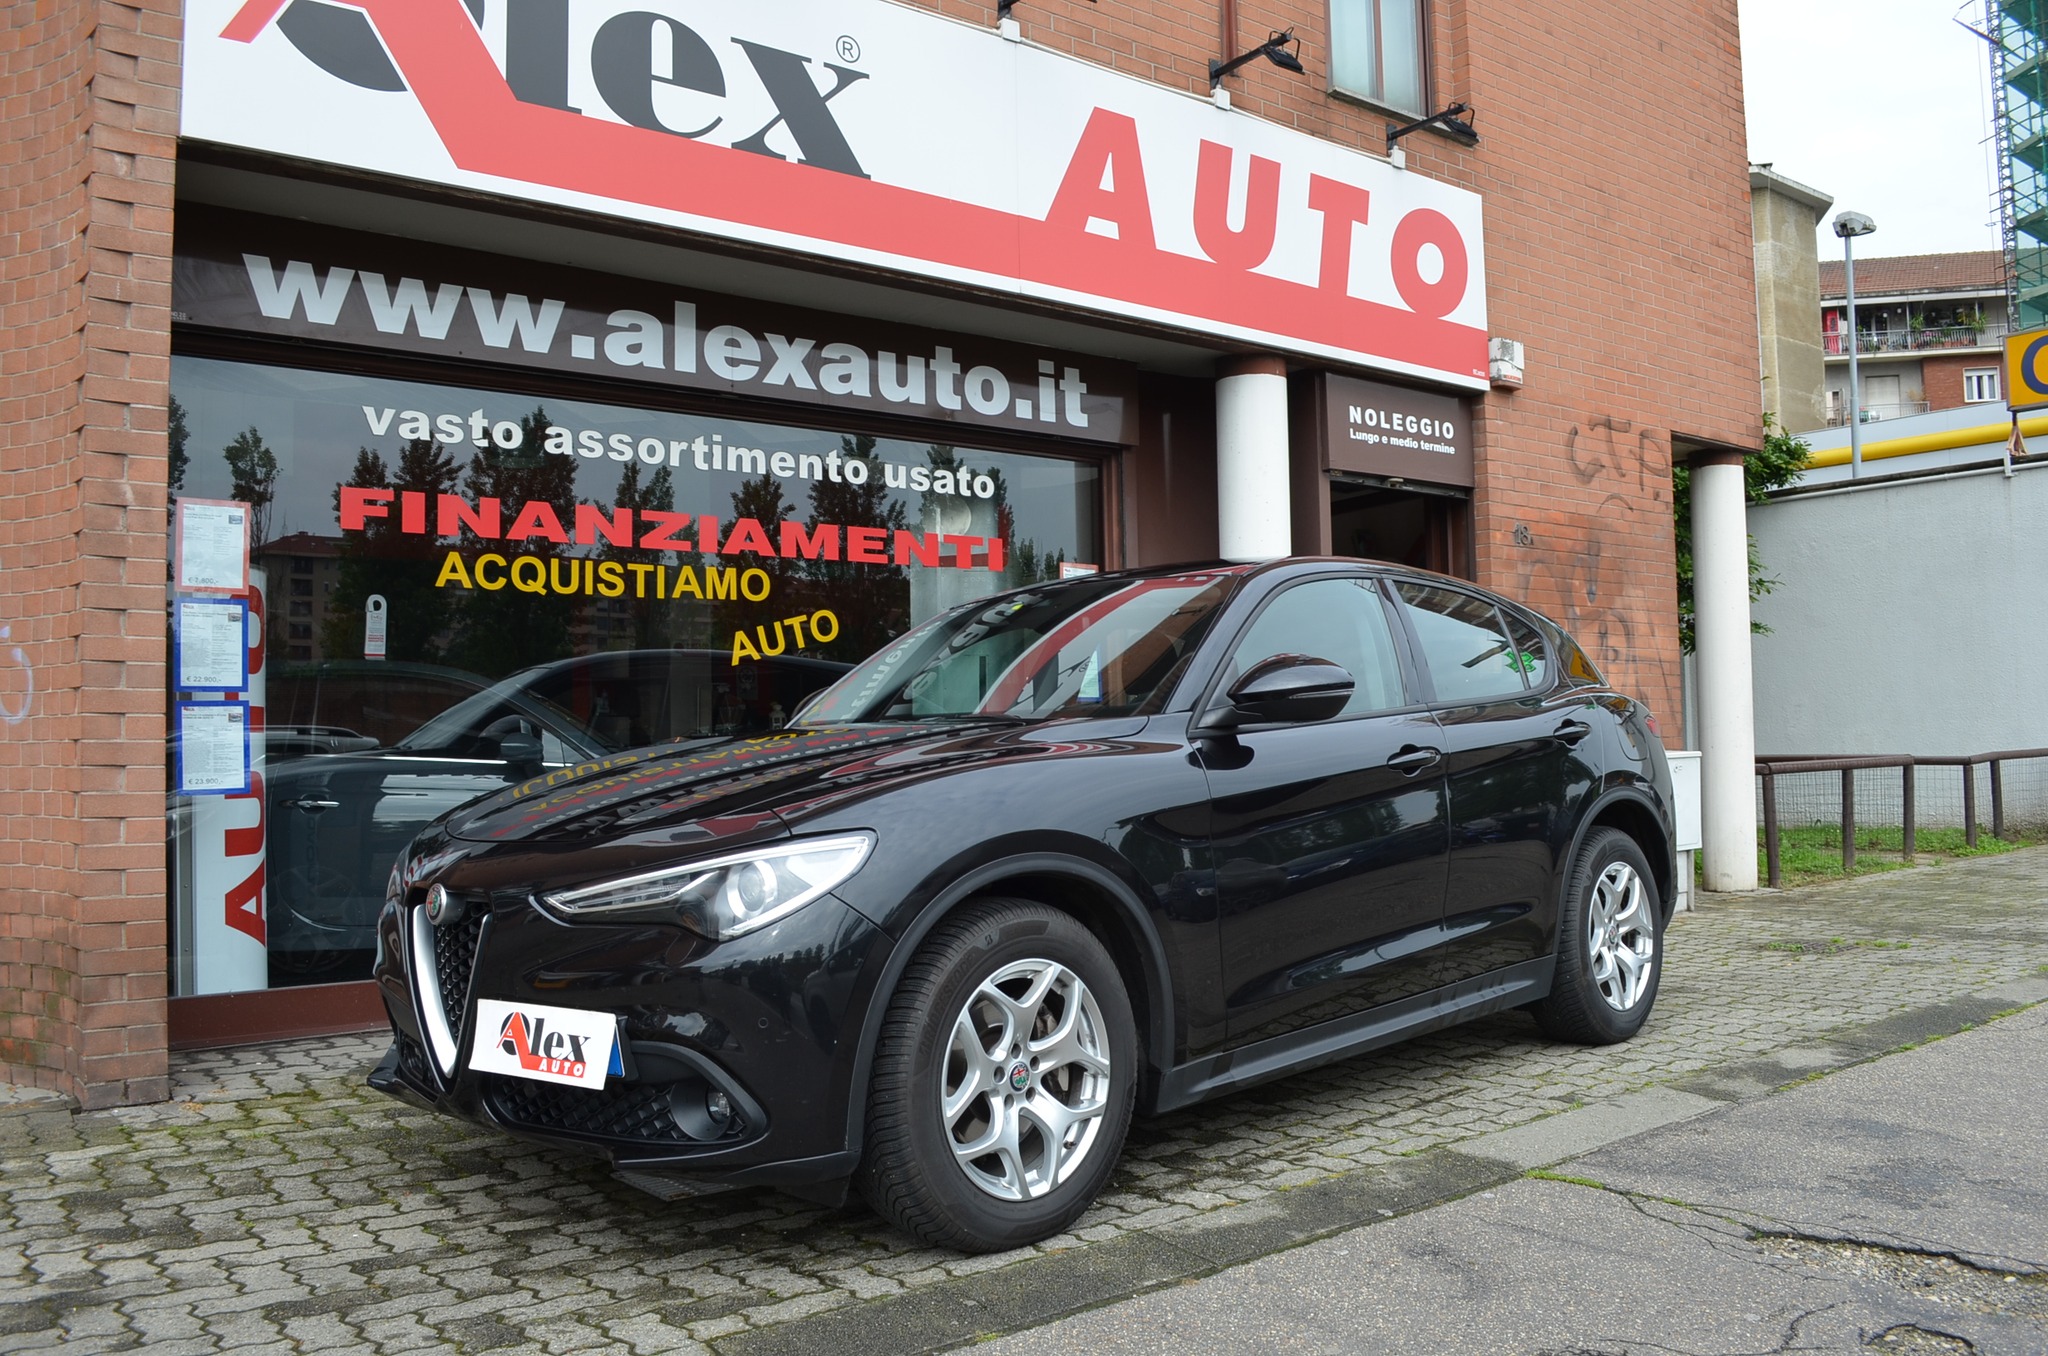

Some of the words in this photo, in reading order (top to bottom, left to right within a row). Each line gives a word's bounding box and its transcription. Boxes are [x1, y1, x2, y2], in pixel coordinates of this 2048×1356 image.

[1044, 106, 1468, 319] AUTO
[242, 252, 1089, 428] www.alexauto.it
[1349, 405, 1454, 439] NOLEGGIO
[1349, 428, 1380, 444] Lungo
[1381, 435, 1389, 444] e
[1390, 436, 1419, 449] medio
[1420, 440, 1456, 455] termine
[362, 405, 522, 450] vasto
[544, 425, 869, 485] assortimento
[884, 464, 995, 499] usato
[339, 486, 1006, 572] FINANZIAMENTI
[435, 551, 771, 602] ACQUISTIAMO
[731, 609, 839, 666] AUTO
[496, 1011, 591, 1065] Alex
[538, 1058, 585, 1077] AUTO
